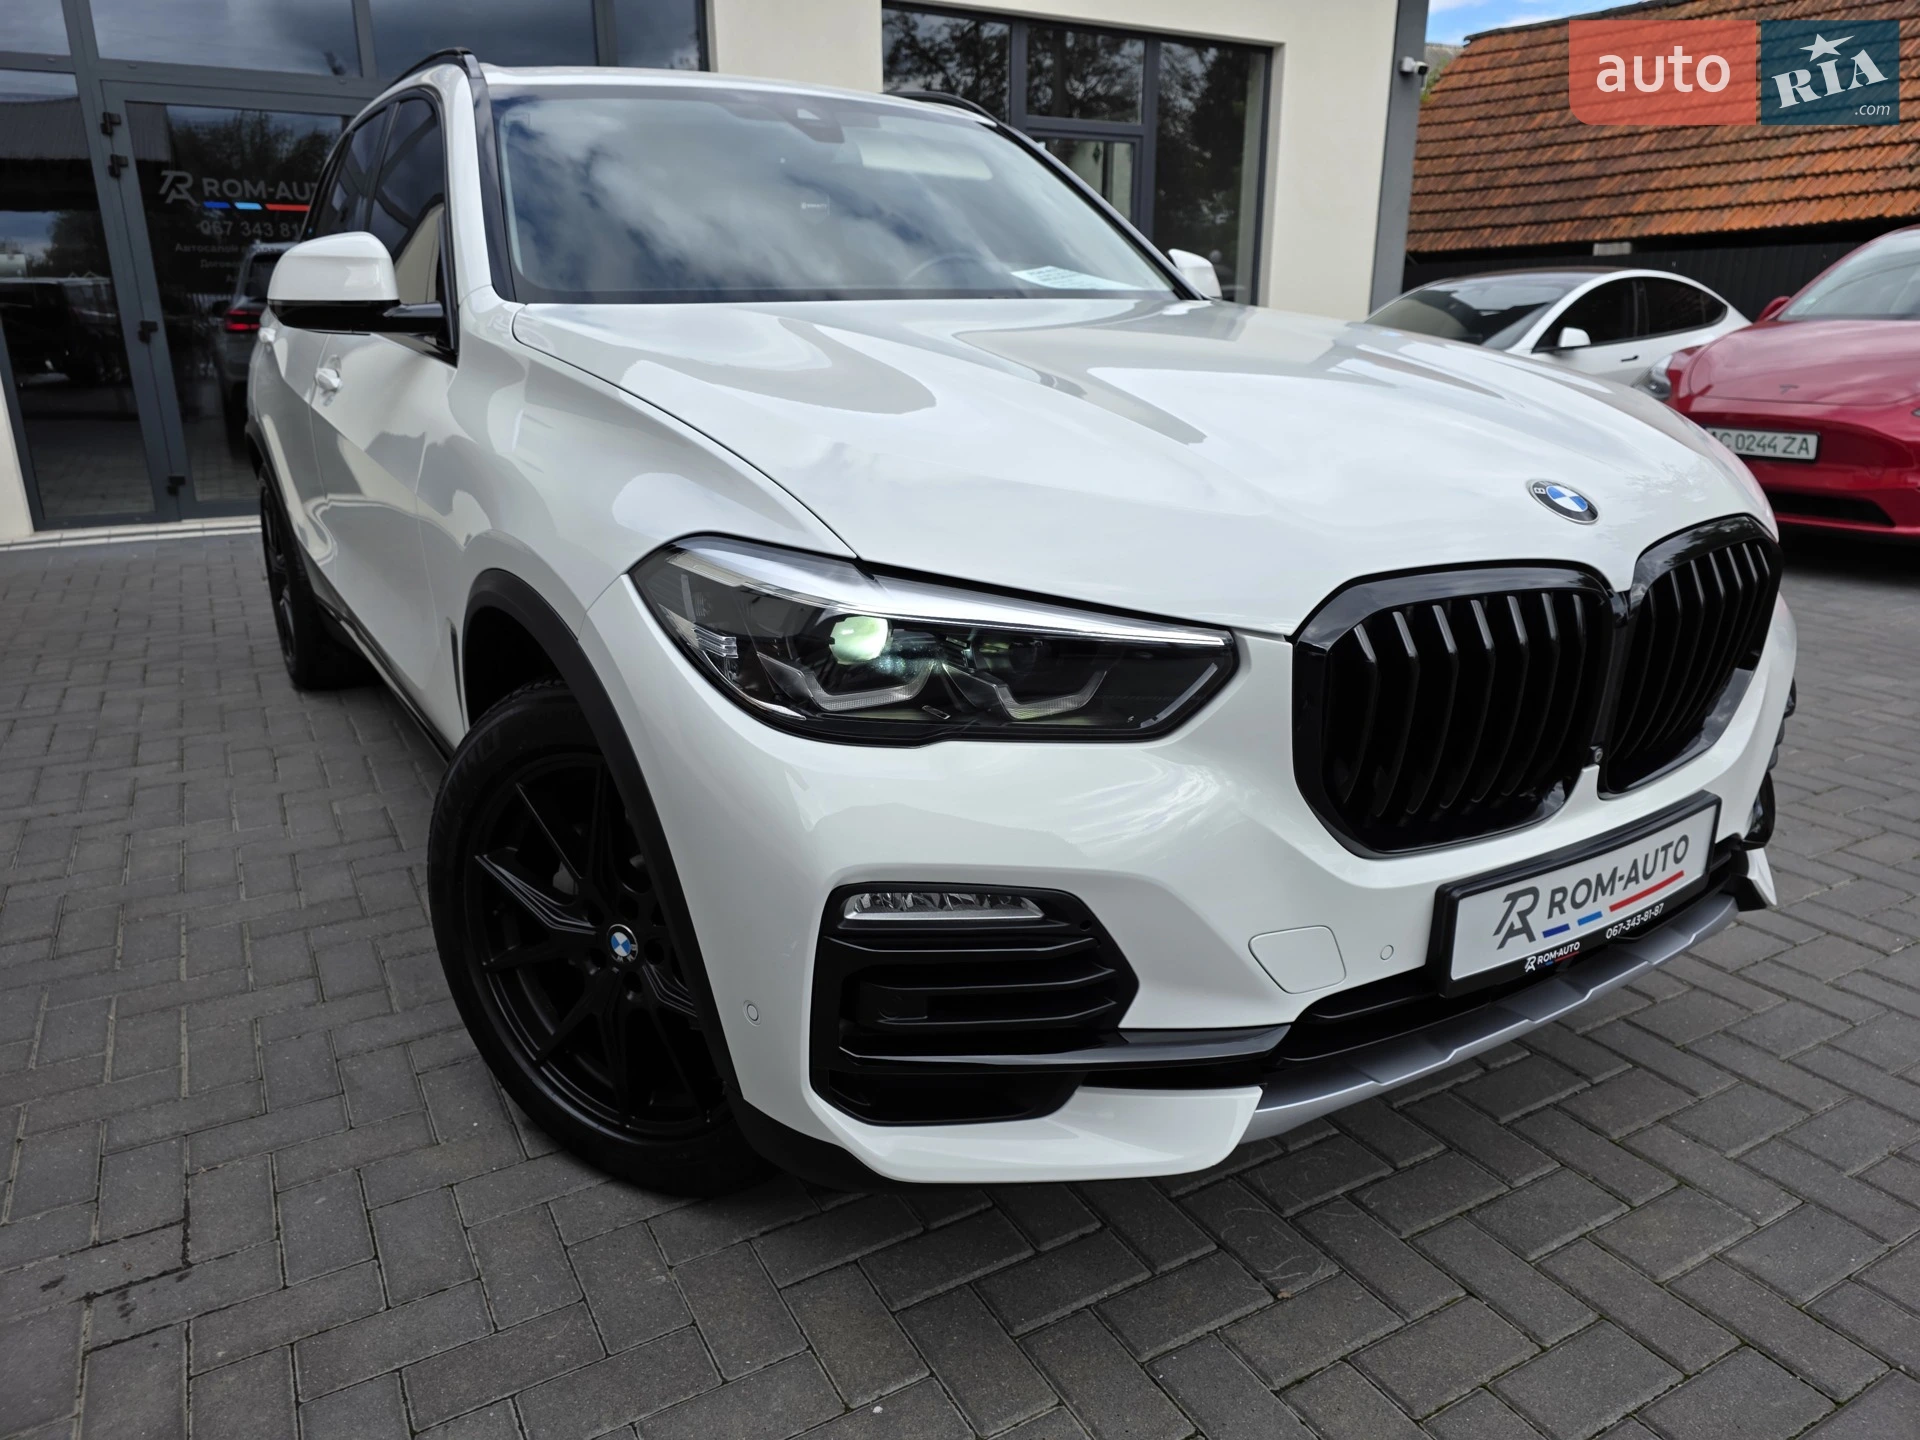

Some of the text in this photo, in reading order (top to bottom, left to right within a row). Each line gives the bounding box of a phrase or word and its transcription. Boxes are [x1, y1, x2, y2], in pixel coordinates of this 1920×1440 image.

[201, 220, 233, 236] 067
[241, 221, 274, 238] 343
[1735, 433, 1778, 453] 0244
[1782, 436, 1810, 456] ZA
[1547, 834, 1689, 919] ROM-AUTO
[1605, 902, 1665, 939] 067-343-81-87
[1537, 941, 1580, 966] ROM-AUTO
